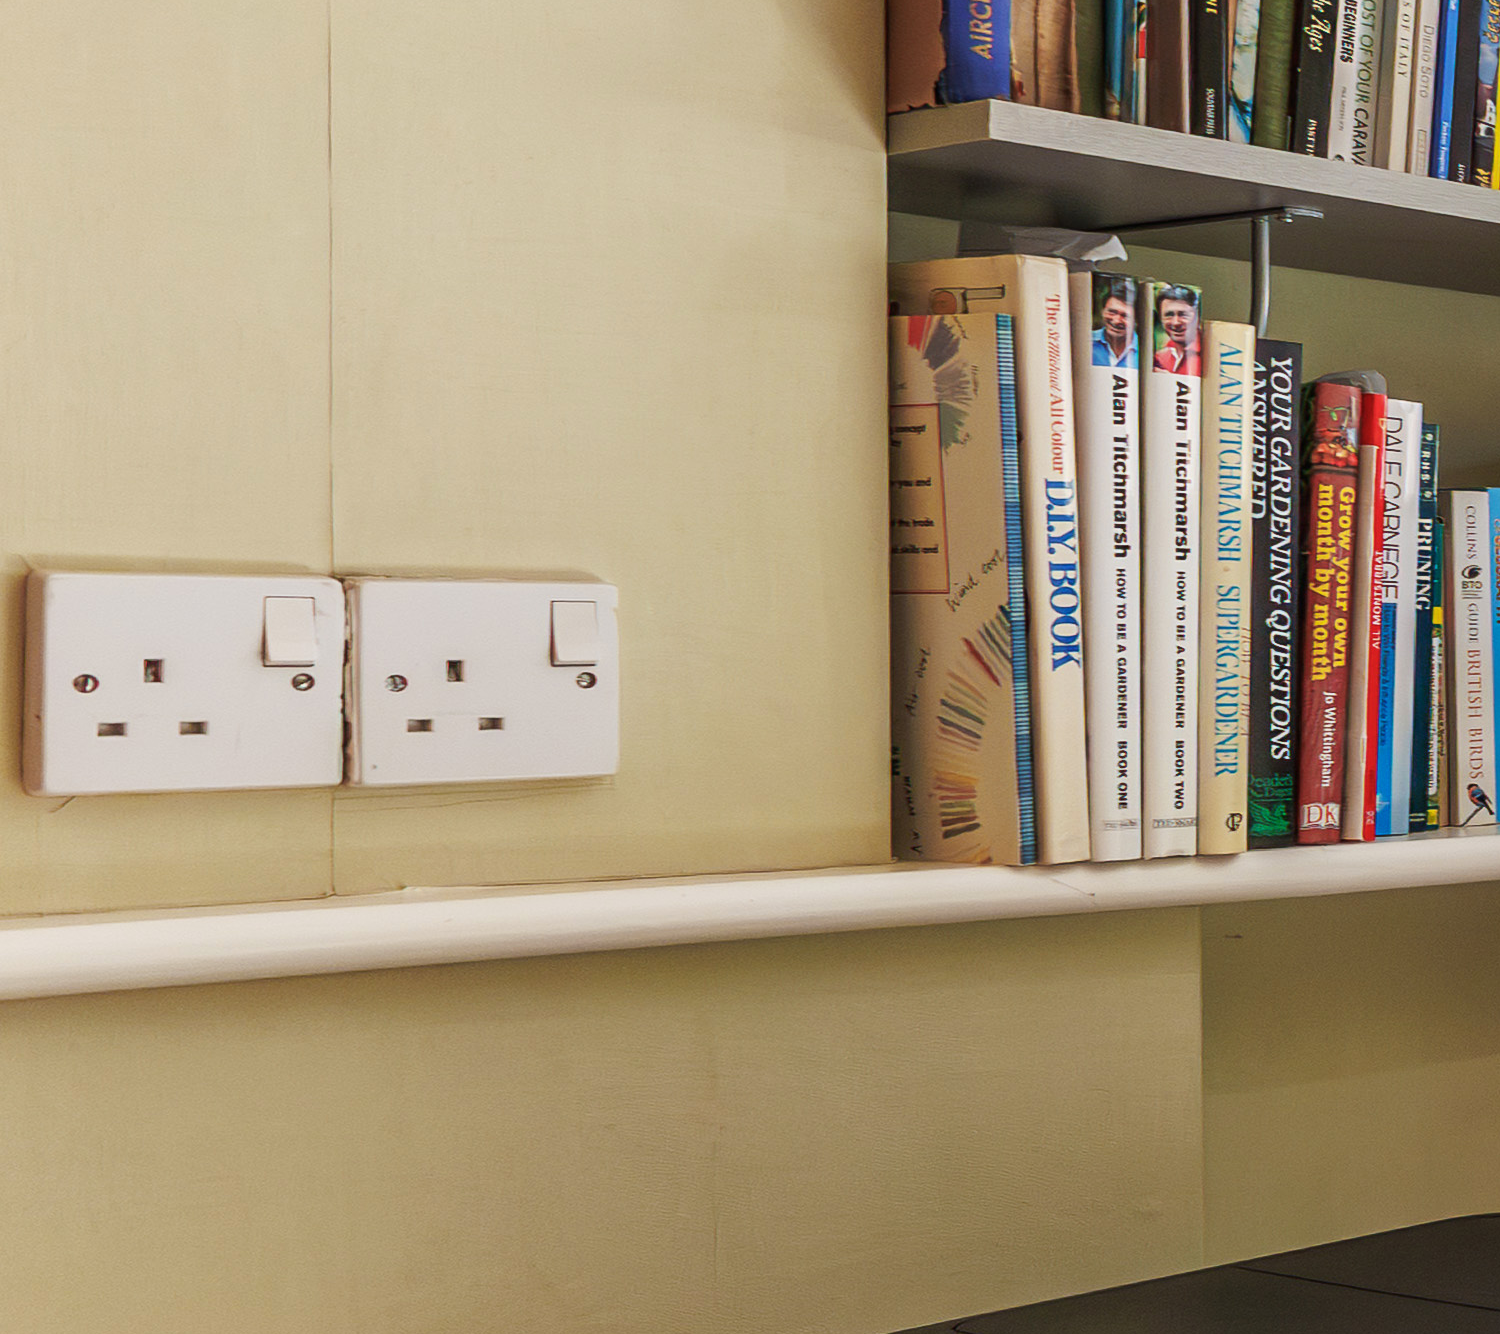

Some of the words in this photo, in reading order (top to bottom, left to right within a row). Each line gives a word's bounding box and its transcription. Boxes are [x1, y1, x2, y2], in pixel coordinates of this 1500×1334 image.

[1304, 15, 1332, 53] Ages
[1400, 13, 1413, 33] OF
[1398, 38, 1412, 78] ITALY
[1112, 374, 1129, 426] Alan
[1219, 343, 1243, 408] ALAN
[1270, 356, 1293, 432] YOUR
[1175, 380, 1192, 432] Alan
[1112, 433, 1132, 559] Titchmarsh
[1175, 439, 1192, 561] Titchmarsh
[1217, 412, 1243, 562] TITCHMARSH
[1045, 478, 1076, 555] D.I.Y.
[1270, 435, 1292, 605] GARDENING
[1315, 484, 1336, 560] month
[1336, 485, 1356, 550] Grow
[1465, 505, 1479, 560] COLLINS
[1115, 568, 1128, 600] HOW
[1175, 571, 1187, 601] HOW
[1309, 568, 1333, 598] by
[1332, 554, 1351, 612] your
[1415, 518, 1433, 611] PRUNING
[1050, 561, 1082, 672] BOOK
[1115, 603, 1128, 619] TO
[1116, 623, 1128, 640] BE
[1175, 604, 1187, 621] TO
[1175, 624, 1187, 641] BE
[1467, 602, 1481, 643] GUIDE
[1116, 644, 1128, 654] A
[1175, 645, 1187, 655] A
[1310, 604, 1332, 681] month
[1333, 617, 1348, 668] own
[1116, 657, 1128, 729] GARDENER
[1174, 658, 1186, 729] GARDENER
[1215, 584, 1242, 777] SUPERGARDENER
[1265, 609, 1291, 760] QUESTIONS
[1323, 690, 1337, 704] Jo
[1467, 649, 1483, 718] BRITISH
[1116, 740, 1128, 778] BOOK
[1174, 740, 1186, 777] BOOK
[1319, 706, 1337, 788] Whittingham
[1469, 728, 1484, 779] BIRDS
[1116, 781, 1128, 810] ONE
[1174, 780, 1186, 810] TWO
[1306, 805, 1337, 824] DK
